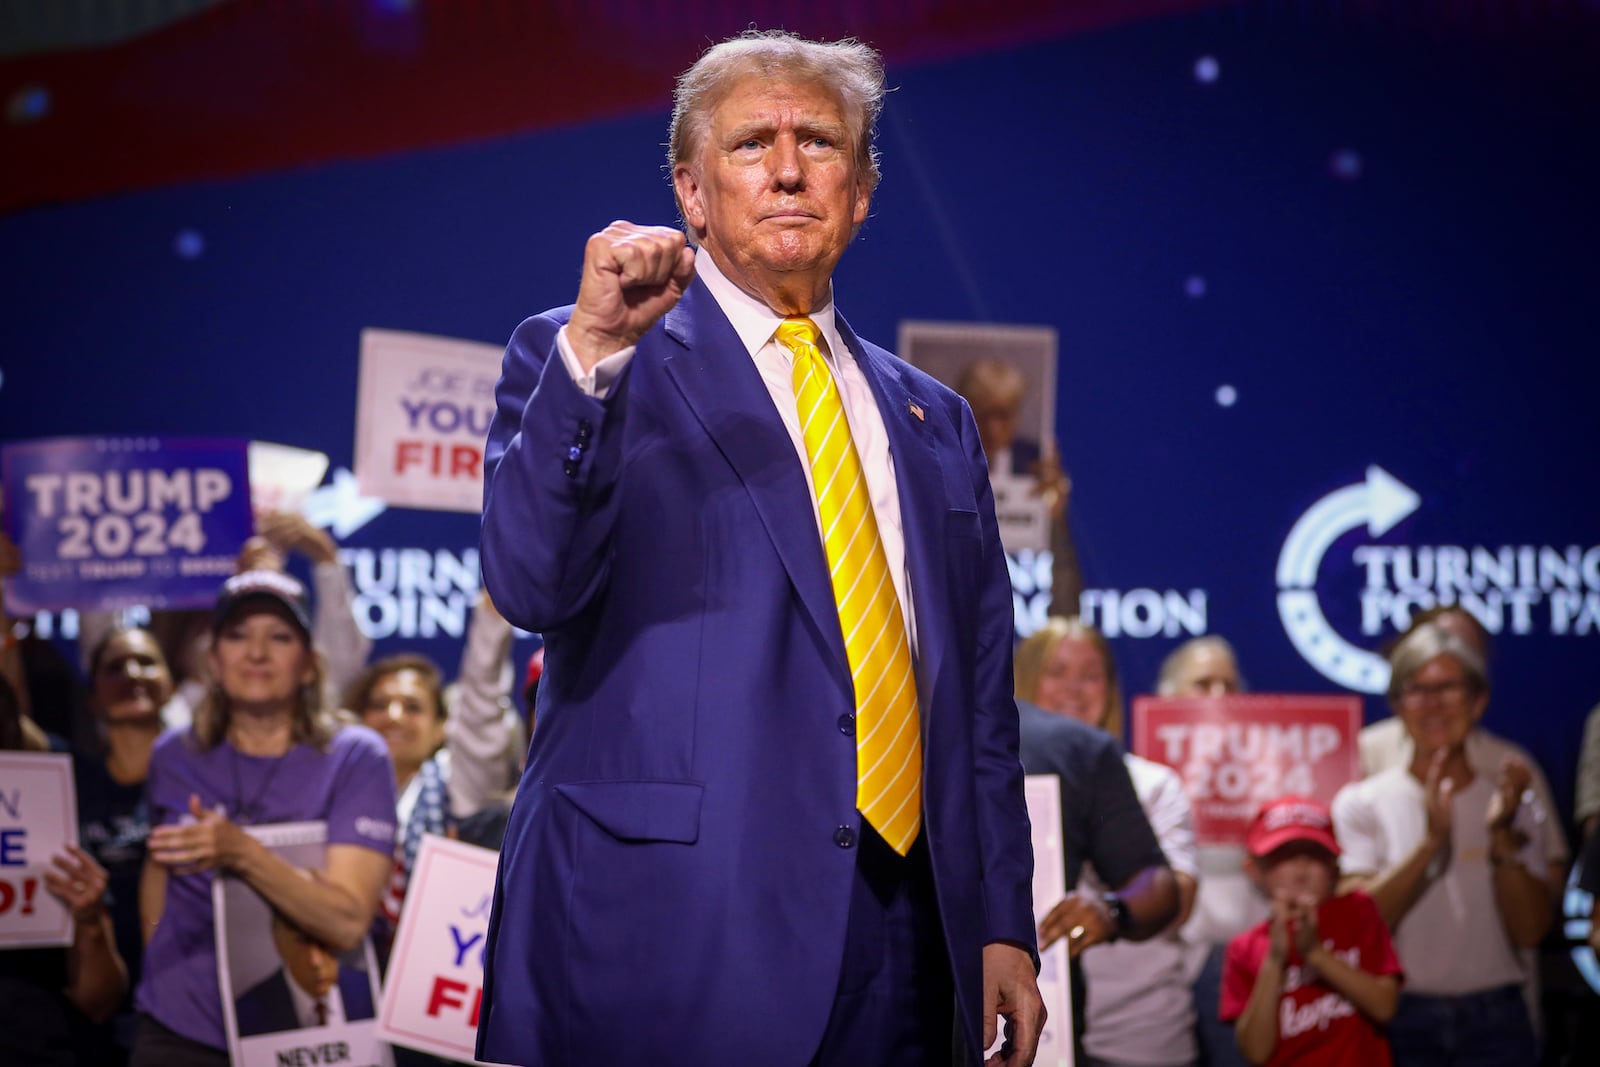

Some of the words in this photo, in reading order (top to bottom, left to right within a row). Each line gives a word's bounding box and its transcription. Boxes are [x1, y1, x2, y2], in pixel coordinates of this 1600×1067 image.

[26, 468, 232, 517] TRUMP
[57, 513, 206, 559] 2024
[1362, 587, 1542, 634] PONT
[1156, 722, 1342, 764] TRUMP
[1183, 759, 1313, 799] 2024
[276, 1041, 350, 1067] NEVER
